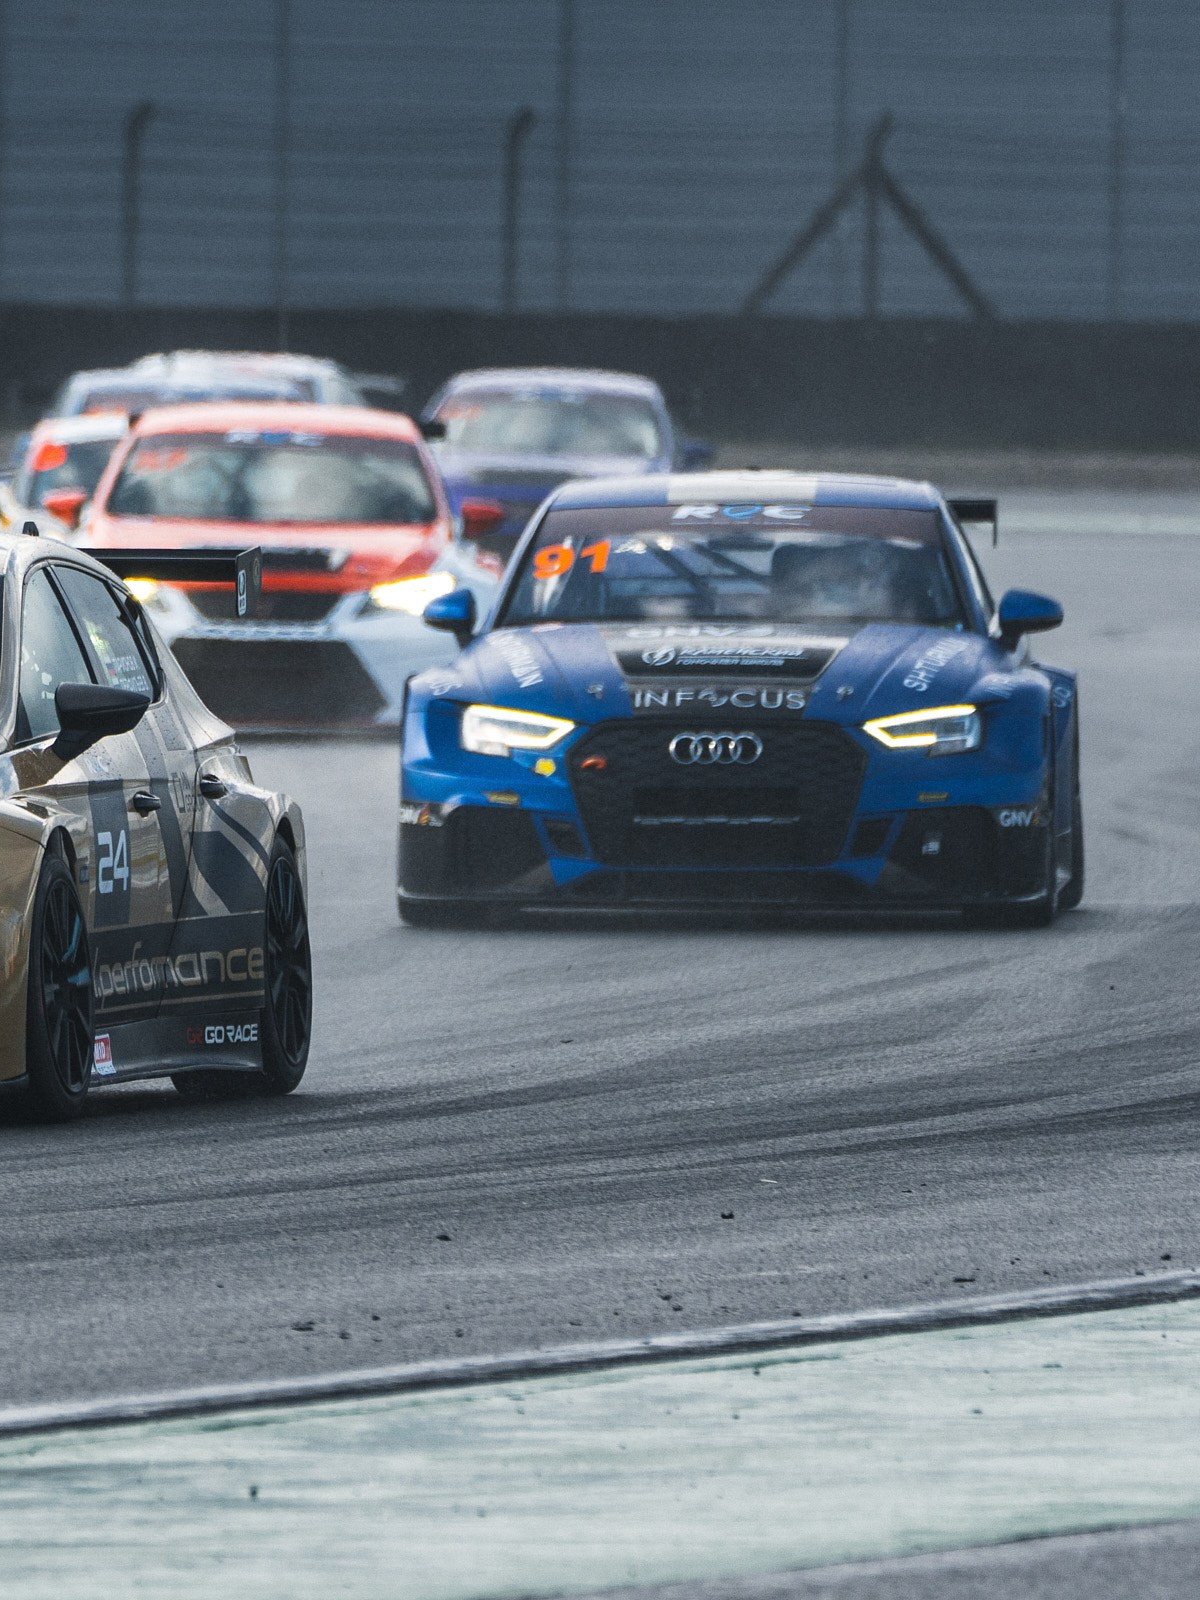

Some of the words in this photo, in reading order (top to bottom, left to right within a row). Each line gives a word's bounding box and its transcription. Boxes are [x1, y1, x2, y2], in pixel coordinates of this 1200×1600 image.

[532, 538, 612, 580] 91
[97, 830, 130, 893] 24
[205, 1026, 225, 1044] GO
[226, 1023, 259, 1043] RACE
